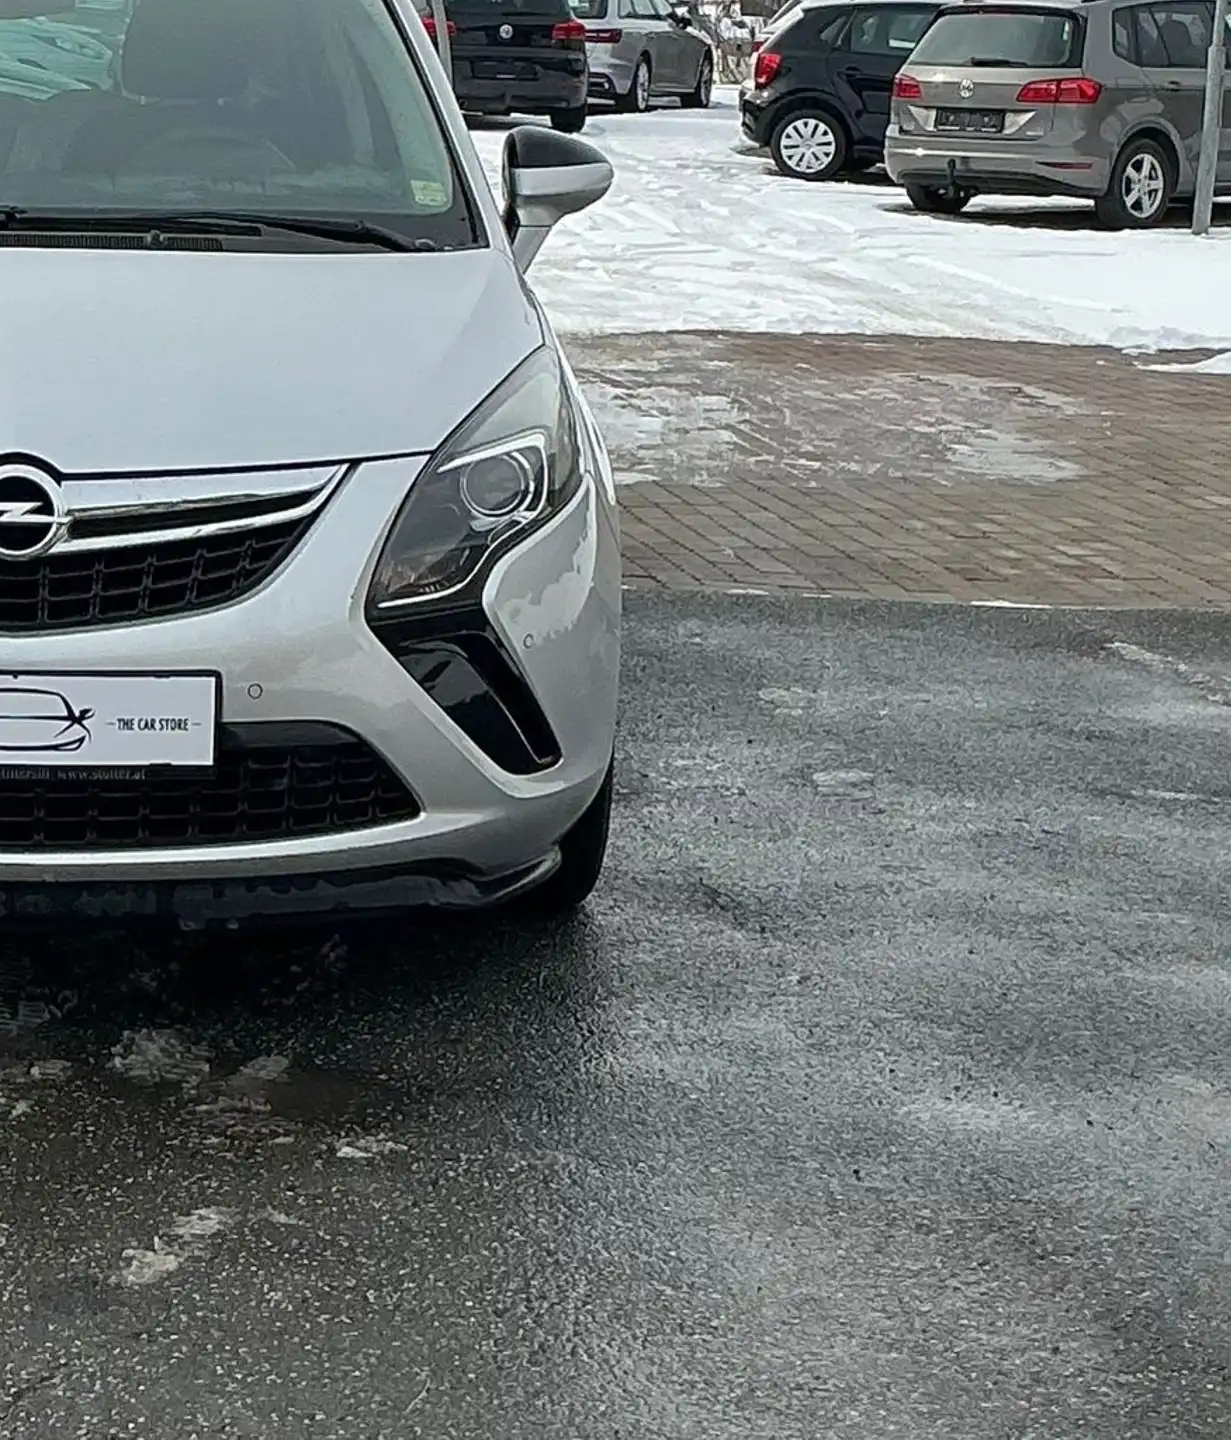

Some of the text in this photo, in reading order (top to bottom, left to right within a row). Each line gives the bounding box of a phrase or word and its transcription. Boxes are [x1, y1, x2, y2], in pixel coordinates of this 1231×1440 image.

[117, 718, 189, 731] THE CAR STORE
